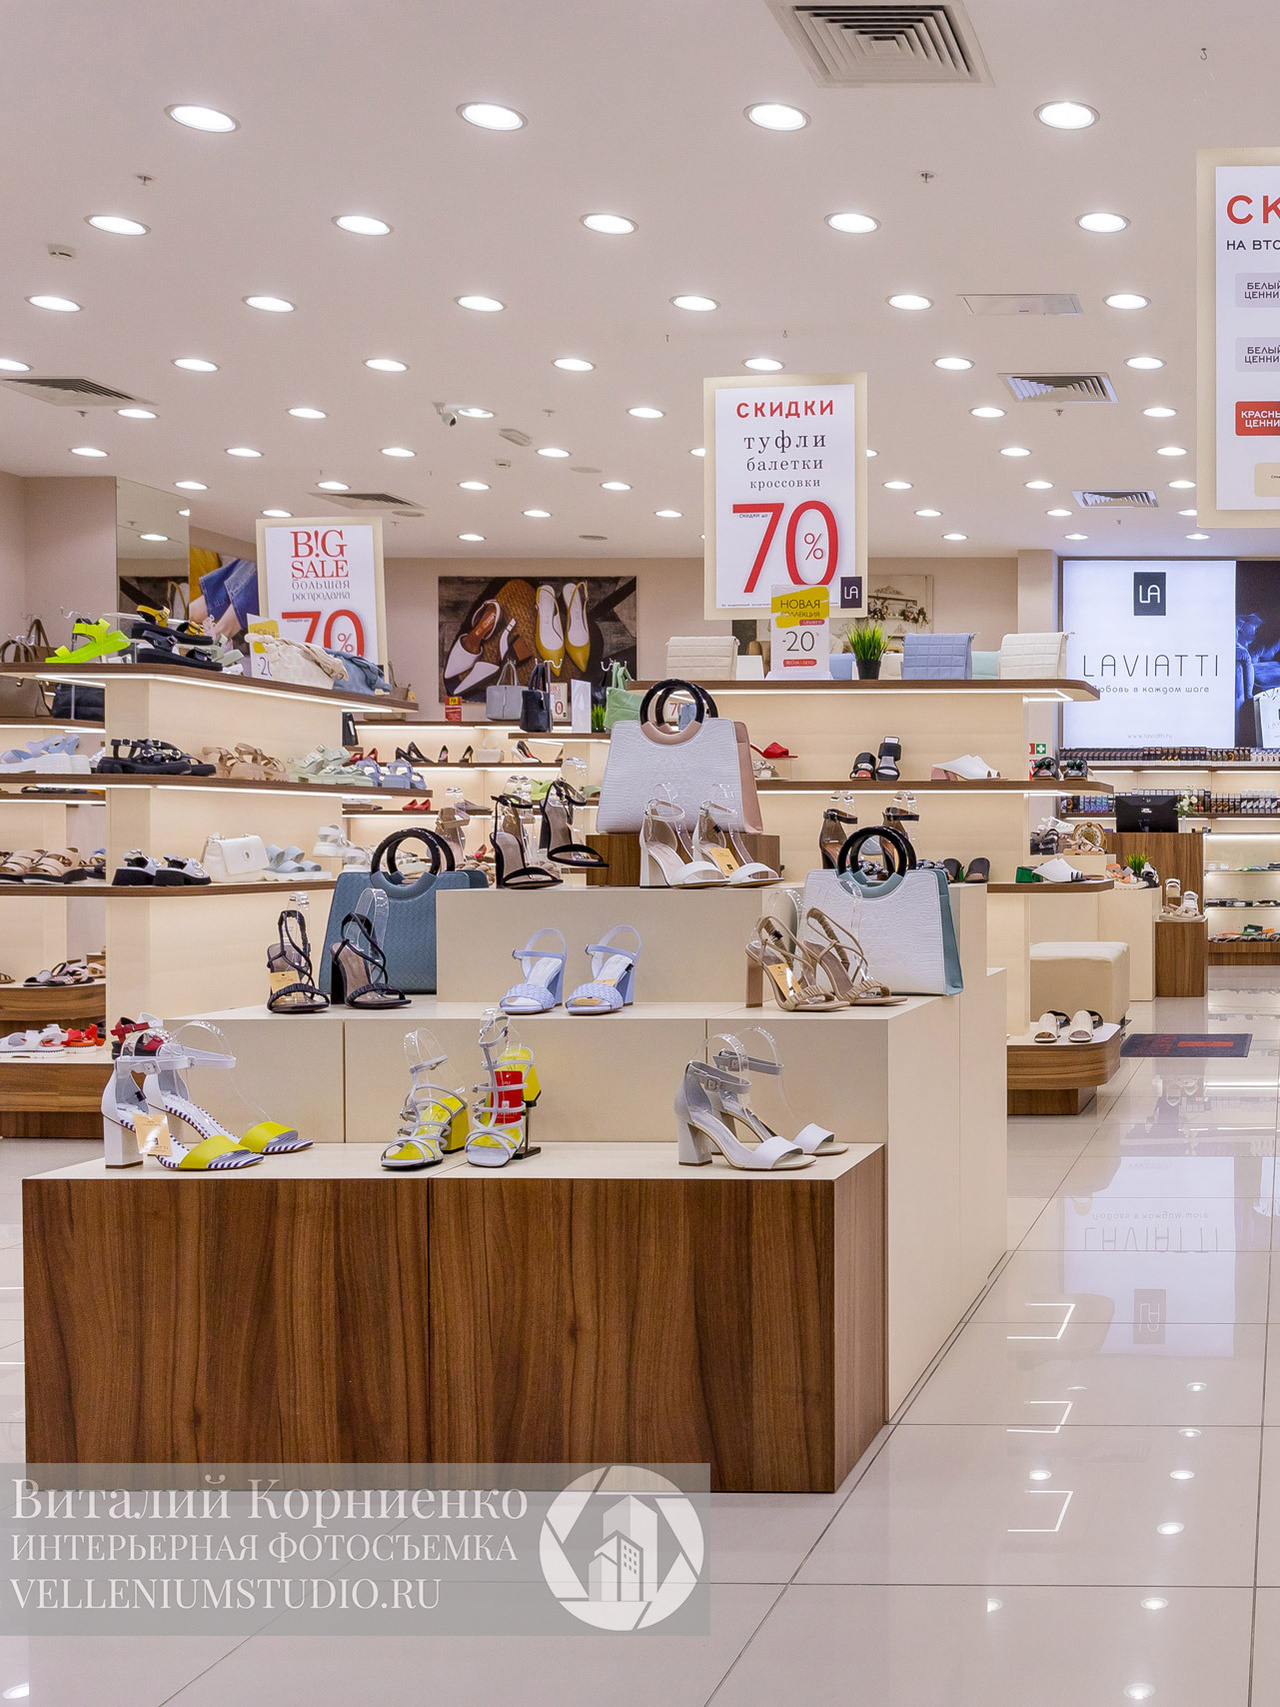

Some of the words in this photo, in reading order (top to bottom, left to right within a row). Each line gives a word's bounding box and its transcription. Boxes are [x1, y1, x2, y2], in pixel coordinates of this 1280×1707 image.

[1226, 240, 1246, 250] НА
[736, 400, 833, 419] СКИДКИ
[743, 430, 826, 454] туфли
[746, 456, 824, 472] балетки
[750, 479, 820, 491] кроссовки
[291, 560, 349, 579] SALE
[292, 578, 350, 590] большая
[292, 591, 351, 602] распродажа
[844, 586, 859, 600] LA
[1139, 584, 1160, 603] LA
[780, 599, 820, 609] НОВАЯ
[1083, 654, 1218, 677] LAVIATTI
[1142, 686, 1182, 695] каждом
